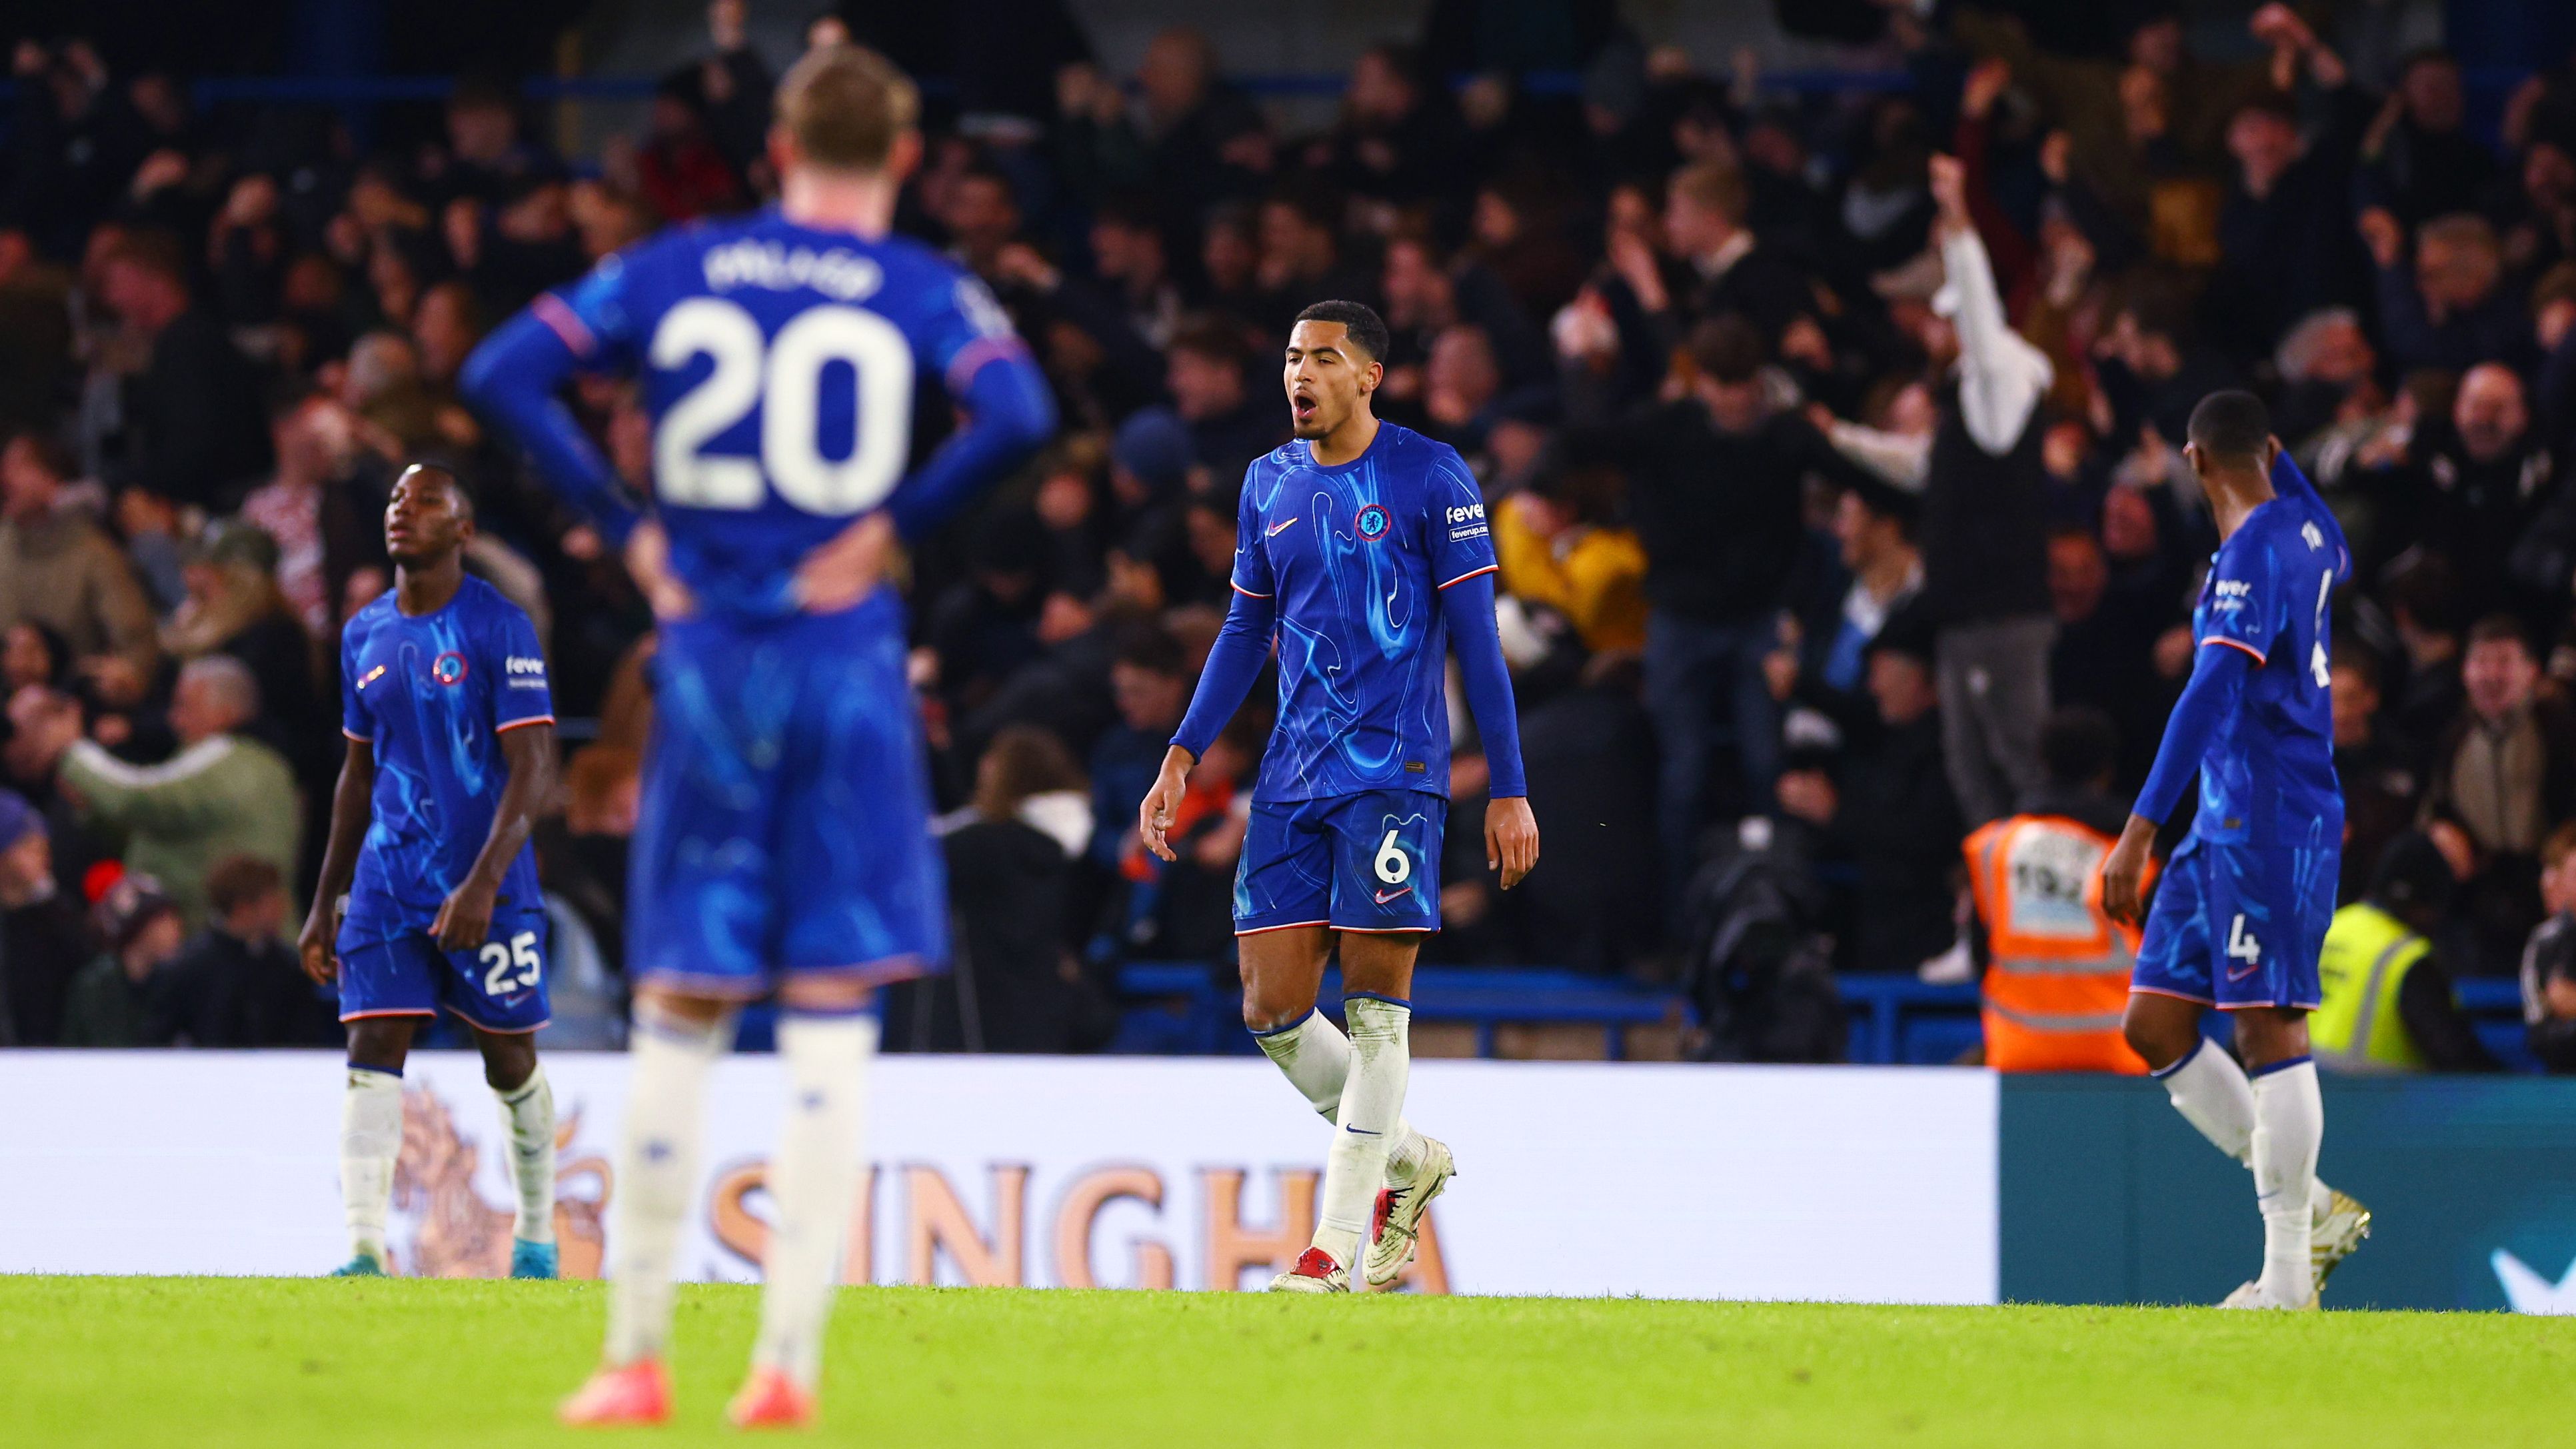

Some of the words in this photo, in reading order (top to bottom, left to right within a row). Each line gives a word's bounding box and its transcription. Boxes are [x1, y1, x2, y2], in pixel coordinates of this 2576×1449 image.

[650, 297, 916, 517] 20
[2215, 580, 2251, 597] ever
[1374, 830, 1410, 884] 6
[479, 931, 541, 995] 25
[2229, 912, 2261, 964] 4
